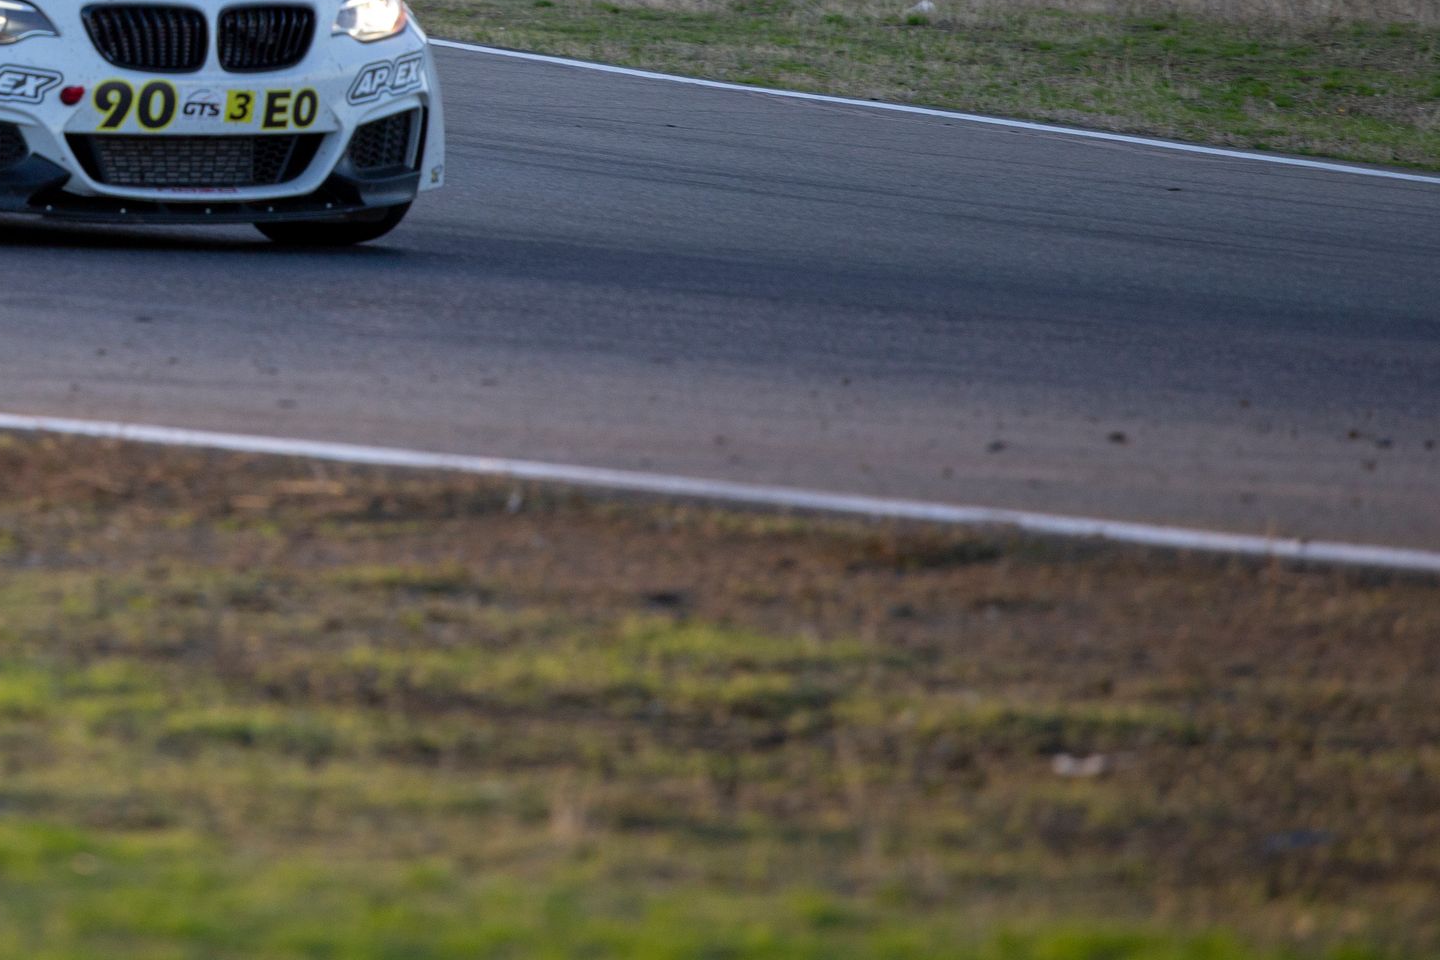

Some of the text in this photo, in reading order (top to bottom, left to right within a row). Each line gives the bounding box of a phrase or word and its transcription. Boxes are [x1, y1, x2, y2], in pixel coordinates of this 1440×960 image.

[358, 56, 422, 99] APEX
[93, 79, 177, 131] 90
[182, 101, 221, 117] GTS
[228, 93, 251, 121] 3
